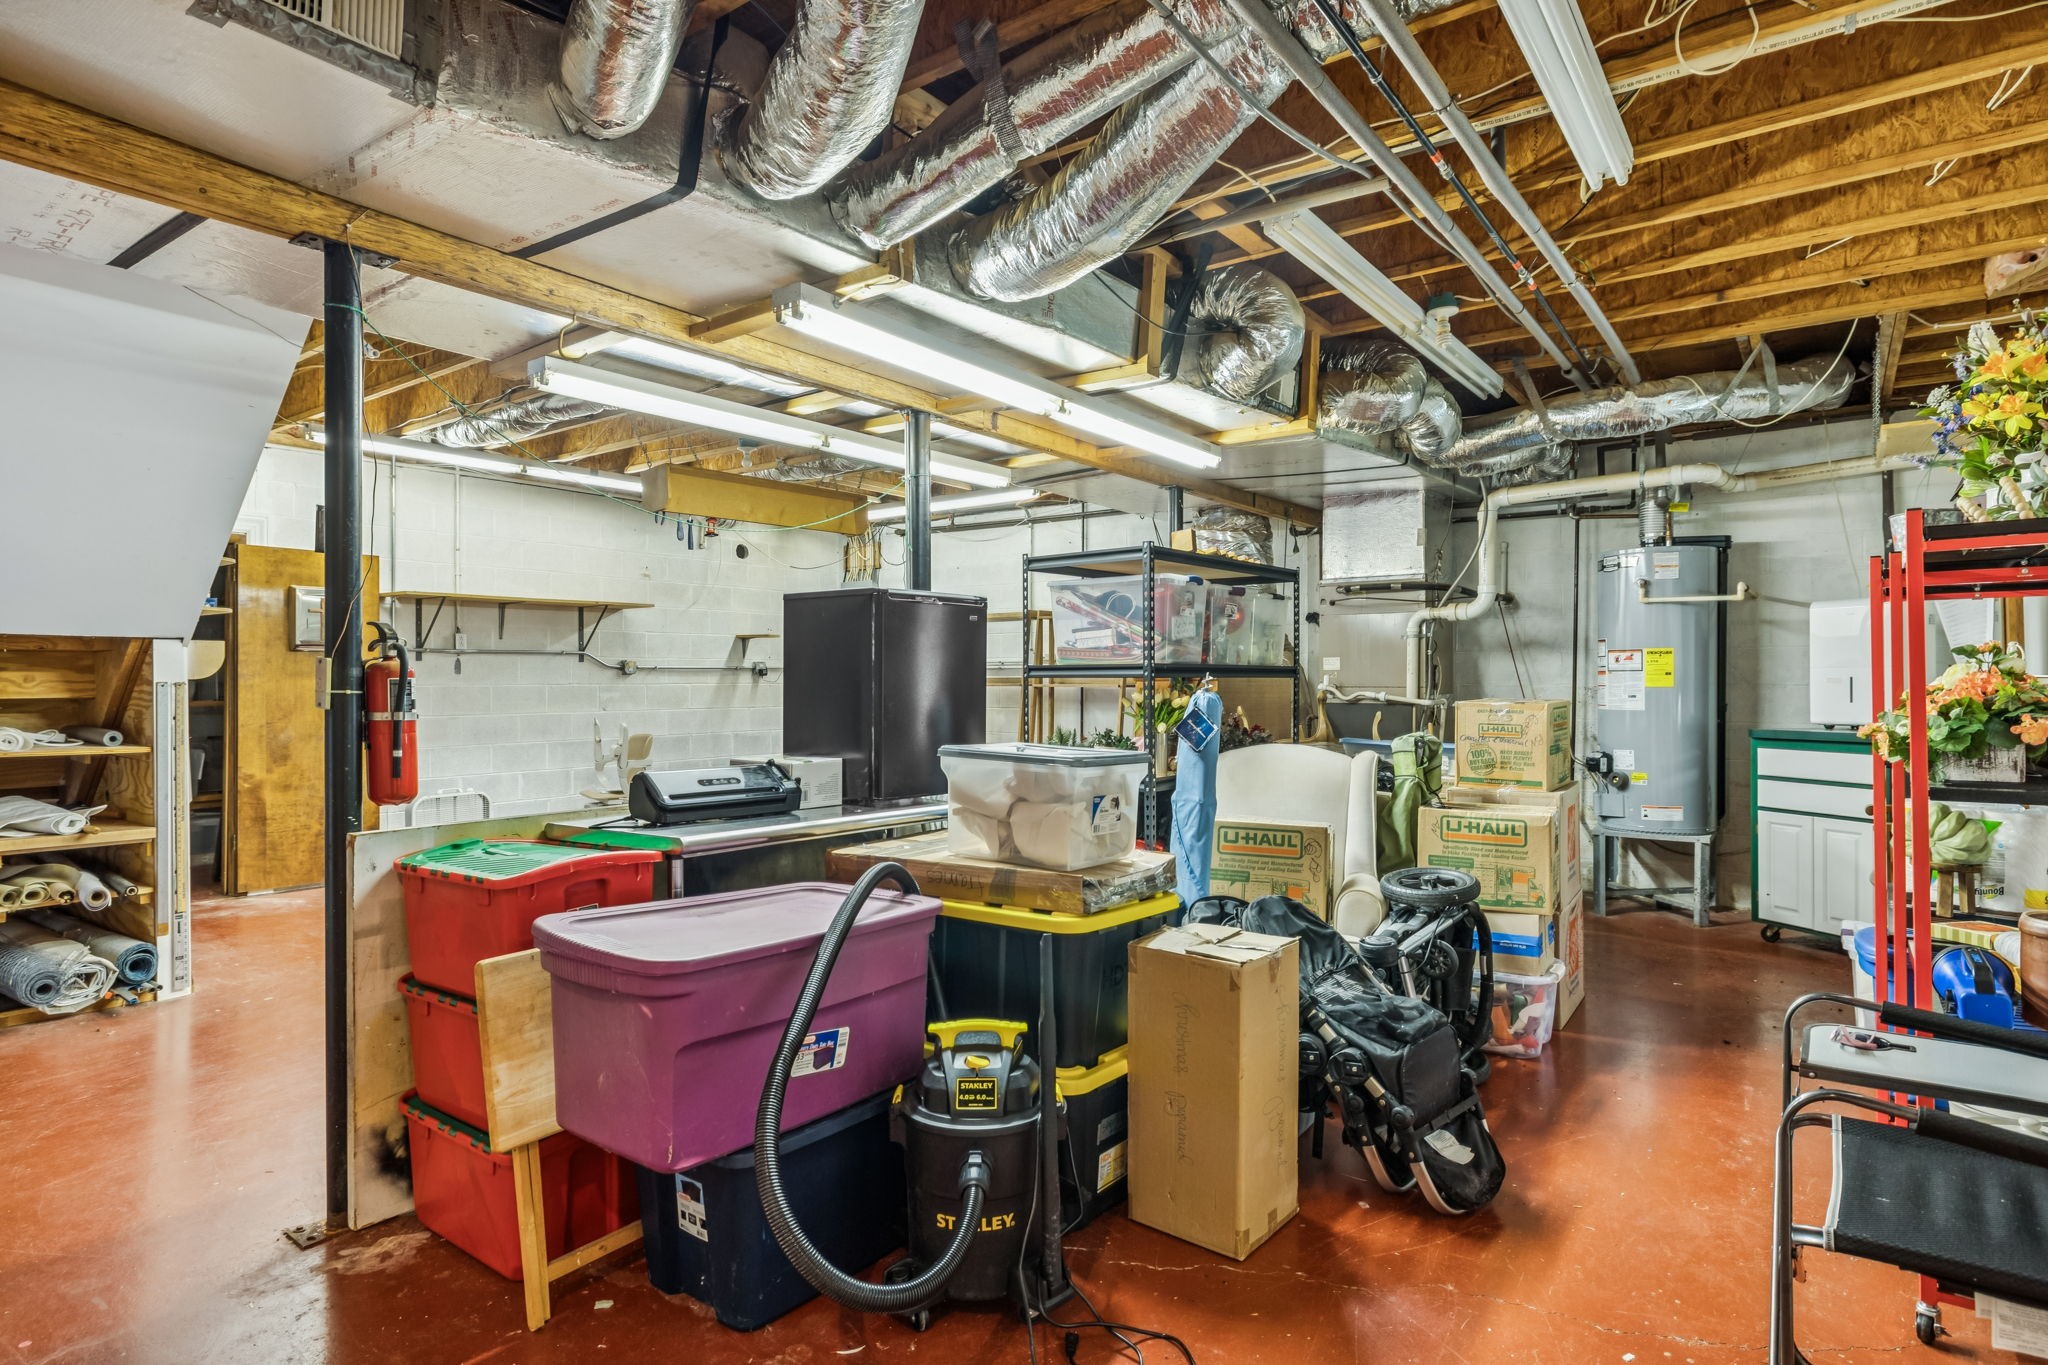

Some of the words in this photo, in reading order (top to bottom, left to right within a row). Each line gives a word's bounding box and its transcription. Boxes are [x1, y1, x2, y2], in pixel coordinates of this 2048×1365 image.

[1470, 749, 1492, 759] 100%
[1446, 820, 1521, 836] U-HAUL
[1223, 831, 1297, 848] U-HAUL
[1975, 887, 2004, 896] Bounty
[936, 1213, 1013, 1232] STLEY
